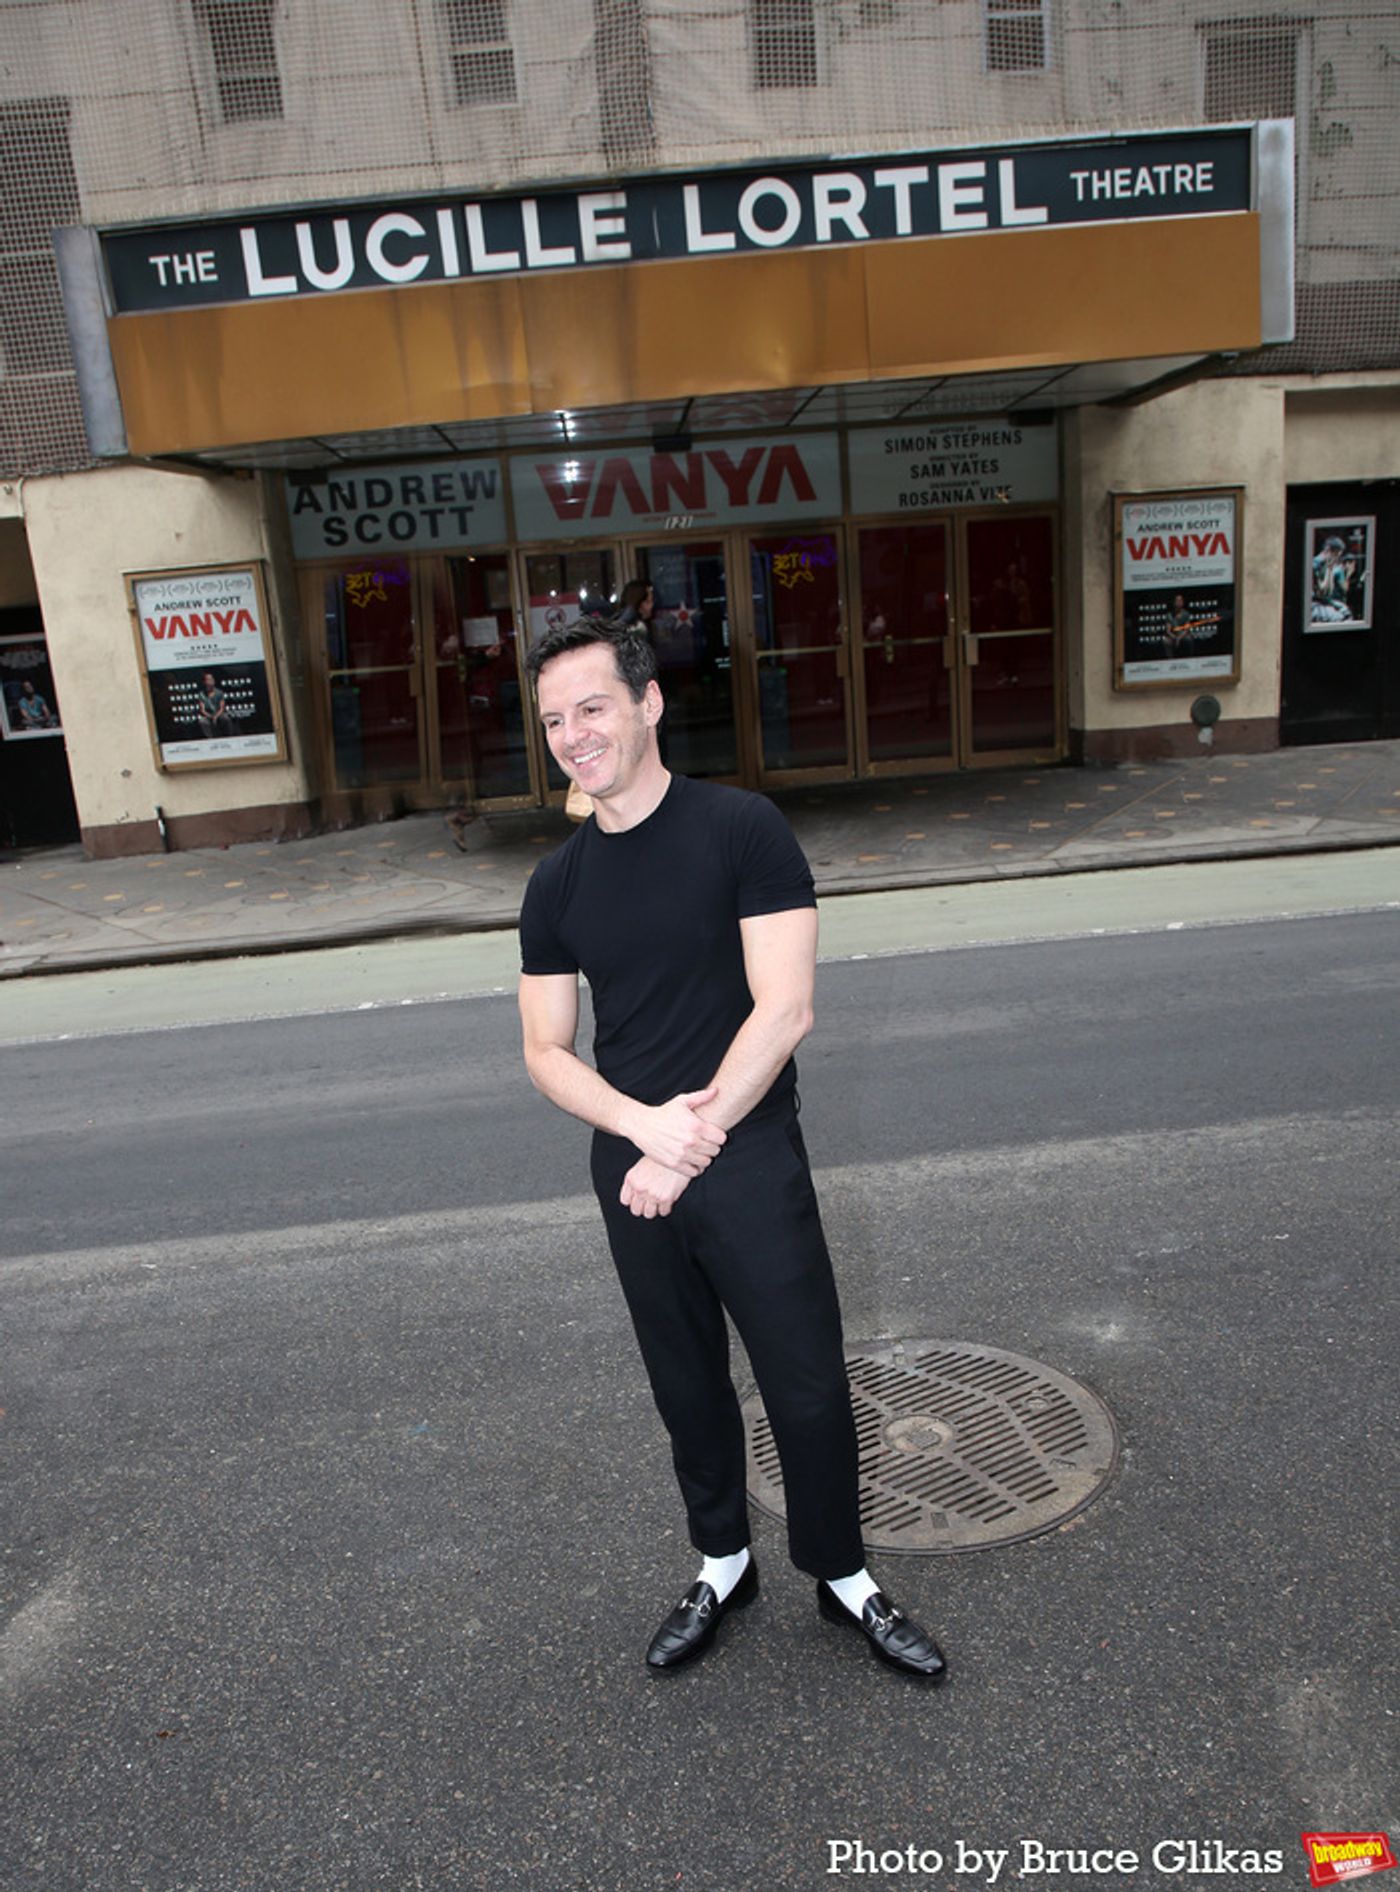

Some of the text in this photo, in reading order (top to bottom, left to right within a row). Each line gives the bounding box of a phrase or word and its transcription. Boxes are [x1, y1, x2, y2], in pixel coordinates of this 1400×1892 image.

[149, 158, 1214, 296] THE LUCILLE LORTEL THEATRE
[884, 430, 1023, 454] SIMON STEPHENS
[534, 444, 818, 521] VANYA
[910, 459, 999, 479] SAM YATES
[293, 469, 497, 514] ANDREW
[899, 489, 973, 507] ROSANNA
[323, 506, 474, 547] SCOTT
[1137, 520, 1220, 533] ANDREW SCOTT
[1126, 532, 1231, 561] VANYA
[154, 596, 241, 611] ANDREW SCOTT
[144, 608, 257, 640] VANYA
